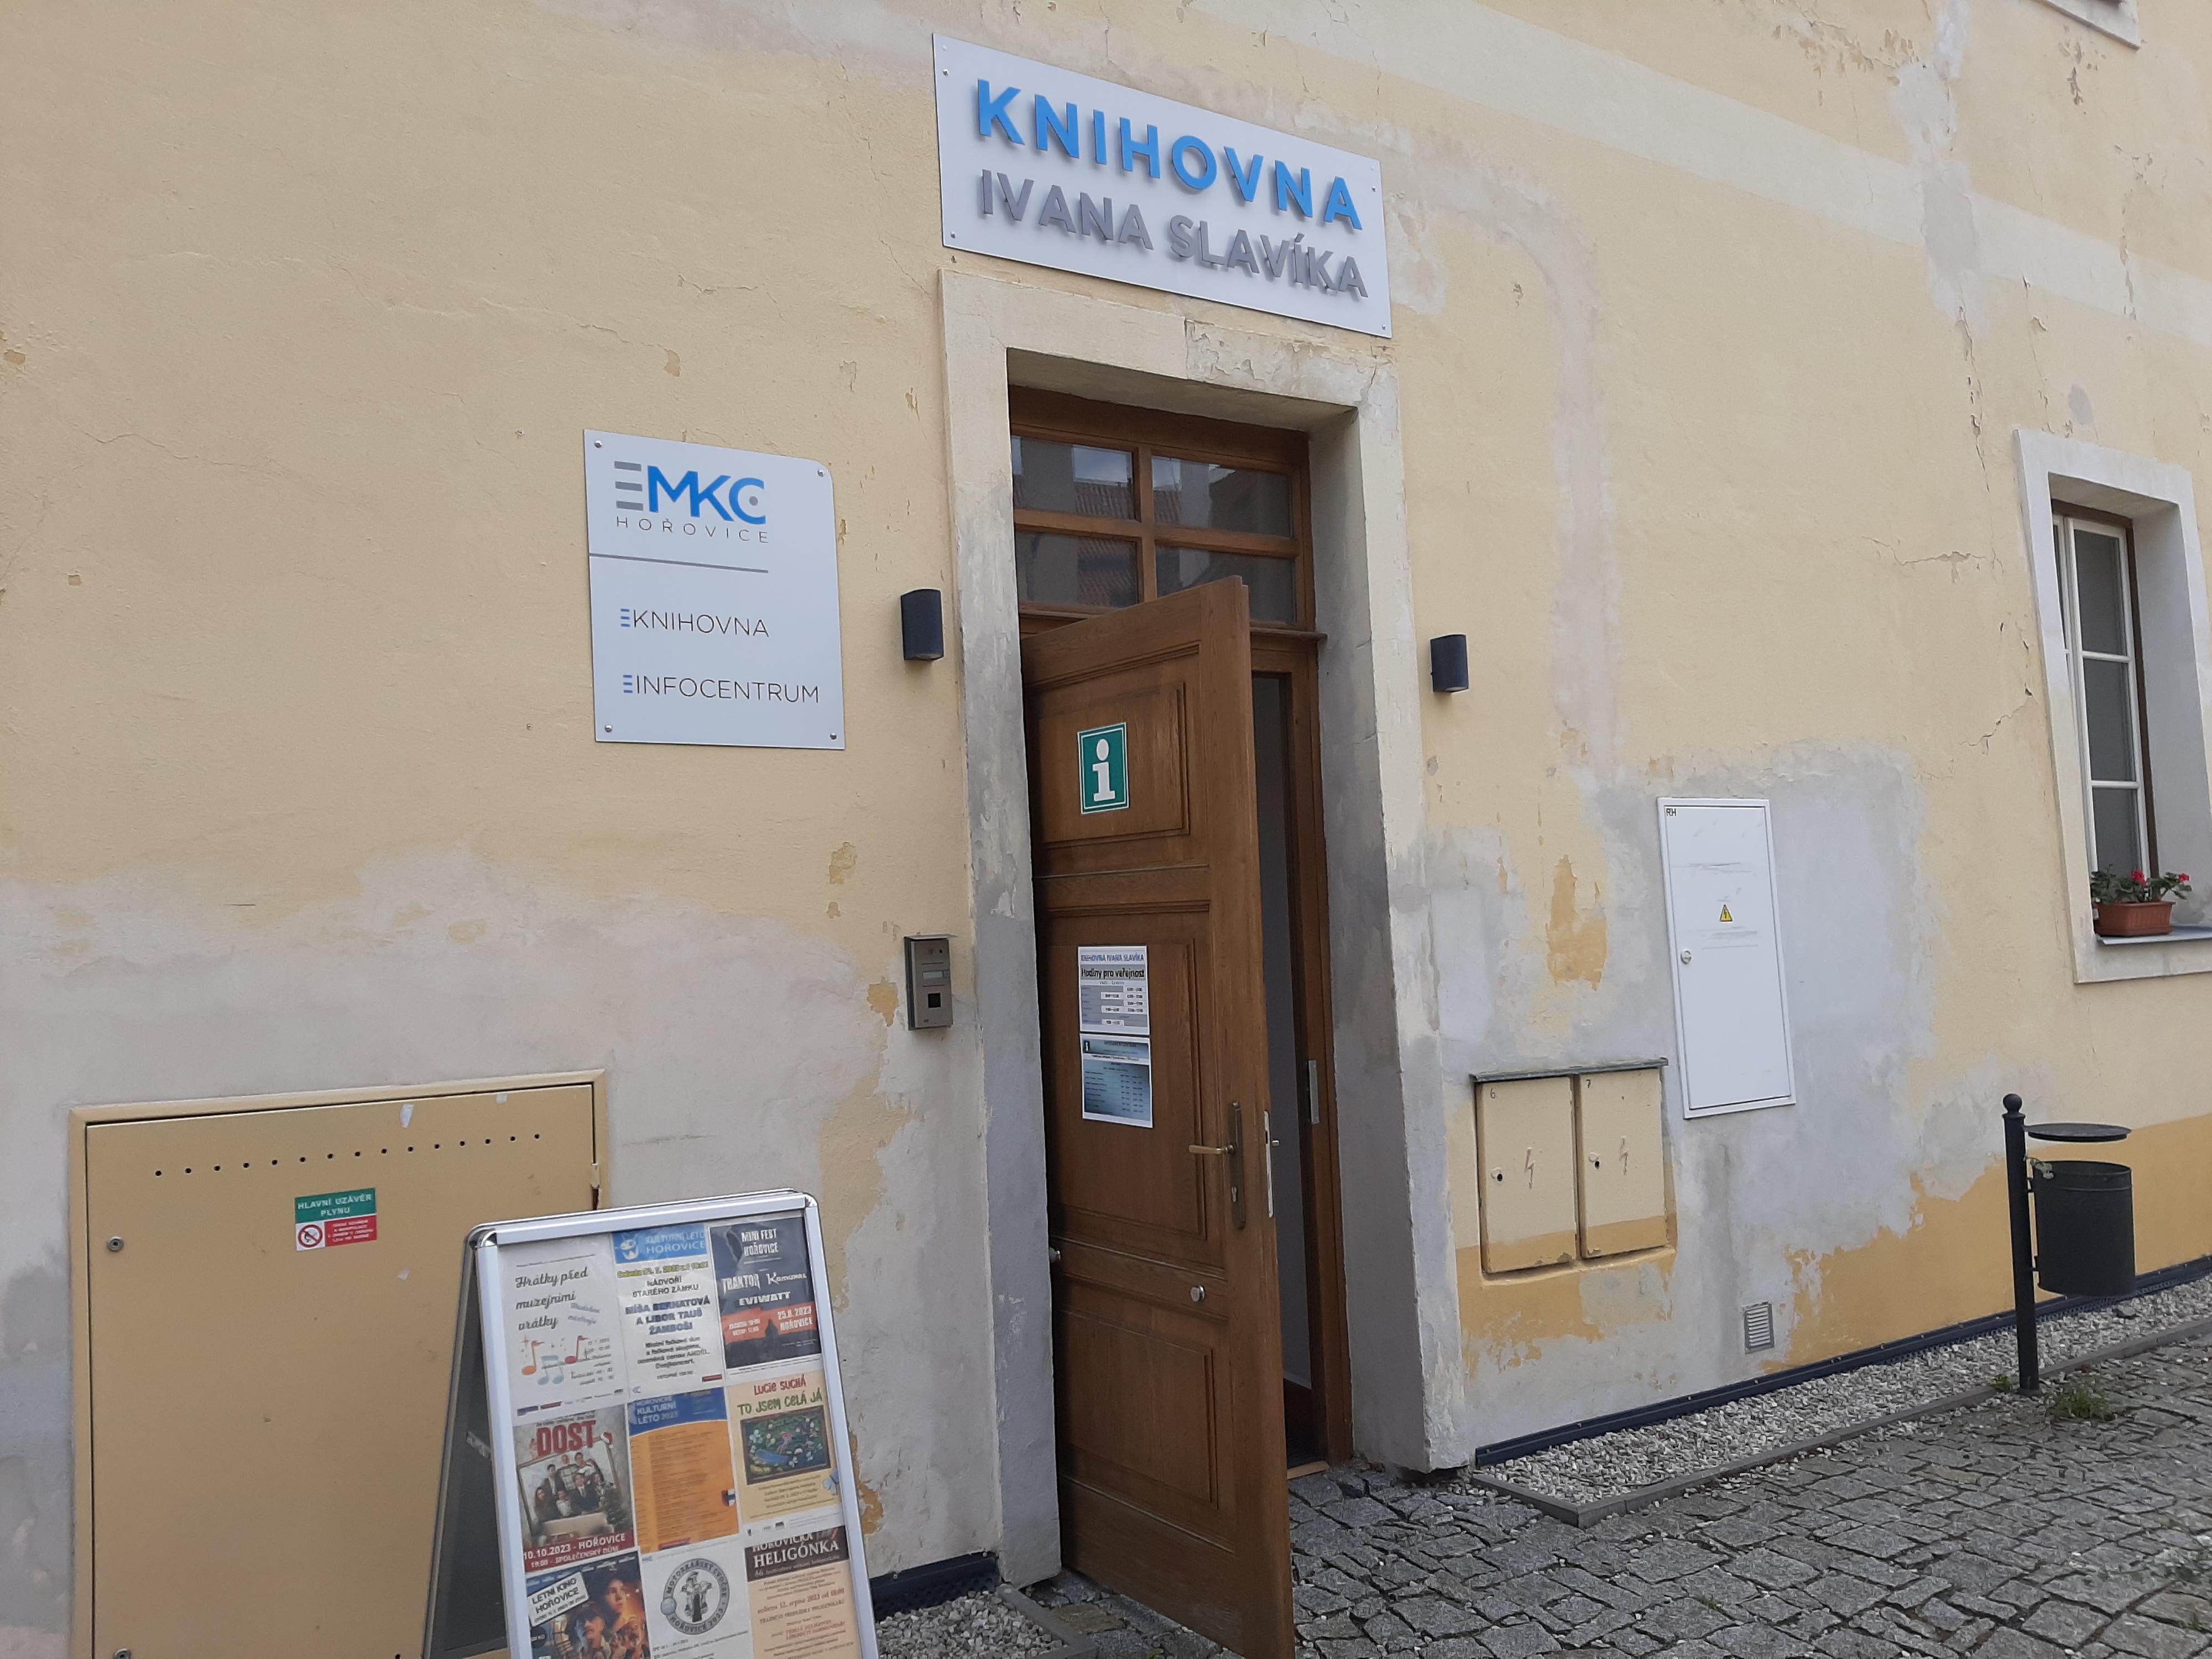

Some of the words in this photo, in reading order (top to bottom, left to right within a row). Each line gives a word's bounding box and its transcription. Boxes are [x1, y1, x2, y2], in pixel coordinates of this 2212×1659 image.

[977, 79, 1363, 230] KNIHOVNA
[982, 169, 1154, 250] IVANA
[1170, 215, 1368, 298] SLAVÍKA
[617, 515, 769, 544] HOŘOVICE
[636, 675, 819, 703] INFOCENTRUM
[1666, 808, 1676, 816] RH
[1081, 968, 1102, 979] Hodiny
[1103, 971, 1114, 980] pro
[1115, 967, 1145, 979] veřejnost
[298, 1199, 331, 1209] HLAVNÍ
[335, 1193, 372, 1205] UZÁVĚR
[321, 1207, 350, 1217] PLYNU
[741, 1230, 759, 1242] MINI
[760, 1228, 777, 1240] FEST
[744, 1241, 779, 1256] HOŘOVICE
[515, 1272, 558, 1288] Hrátky
[560, 1266, 588, 1286] před
[721, 1274, 761, 1296] TRAKTOR
[515, 1291, 576, 1310] muzejními
[518, 1314, 558, 1331] vrátky
[636, 1317, 643, 1325] A
[780, 1374, 806, 1390] SUCHÁ
[637, 1401, 676, 1415] KULTURNÍ
[737, 1403, 752, 1416] TO
[810, 1387, 822, 1403] JÁ
[638, 1413, 660, 1425] LÉTO
[536, 1420, 596, 1457] DOST
[578, 1533, 626, 1550] HOŘOVICE
[753, 1540, 839, 1568] HELIGÓNKA
